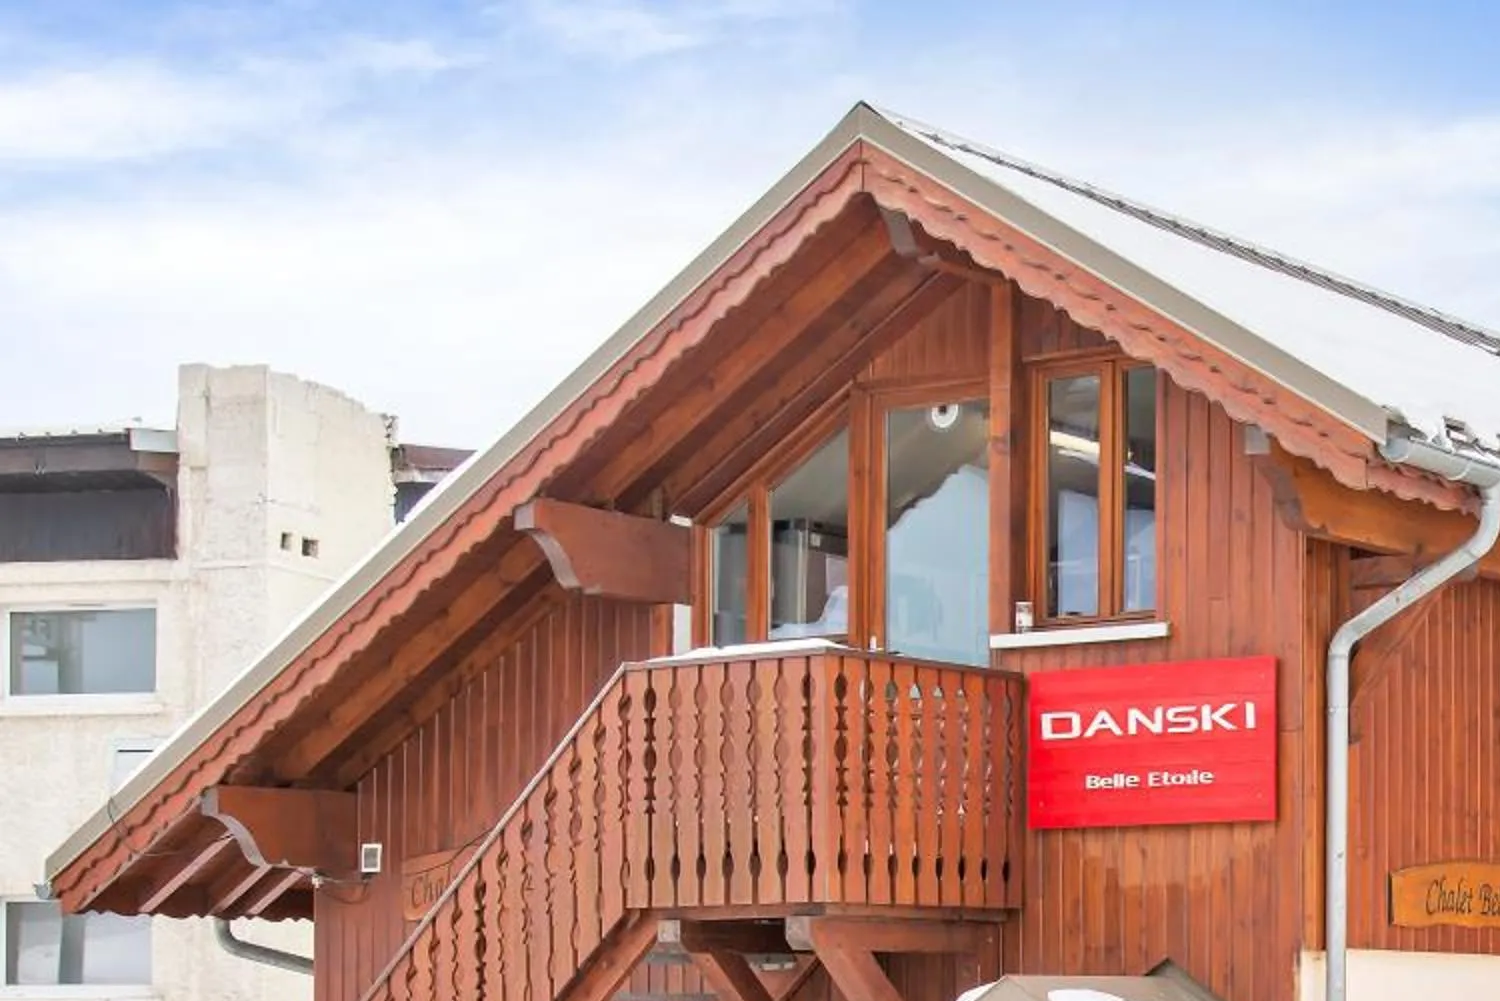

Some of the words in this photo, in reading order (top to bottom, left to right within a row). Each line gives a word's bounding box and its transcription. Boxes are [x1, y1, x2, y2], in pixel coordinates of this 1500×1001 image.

[1041, 701, 1256, 740] DANSKI
[1085, 772, 1140, 789] Belle
[1148, 769, 1214, 788] Etoile
[1425, 874, 1474, 916] Chalet
